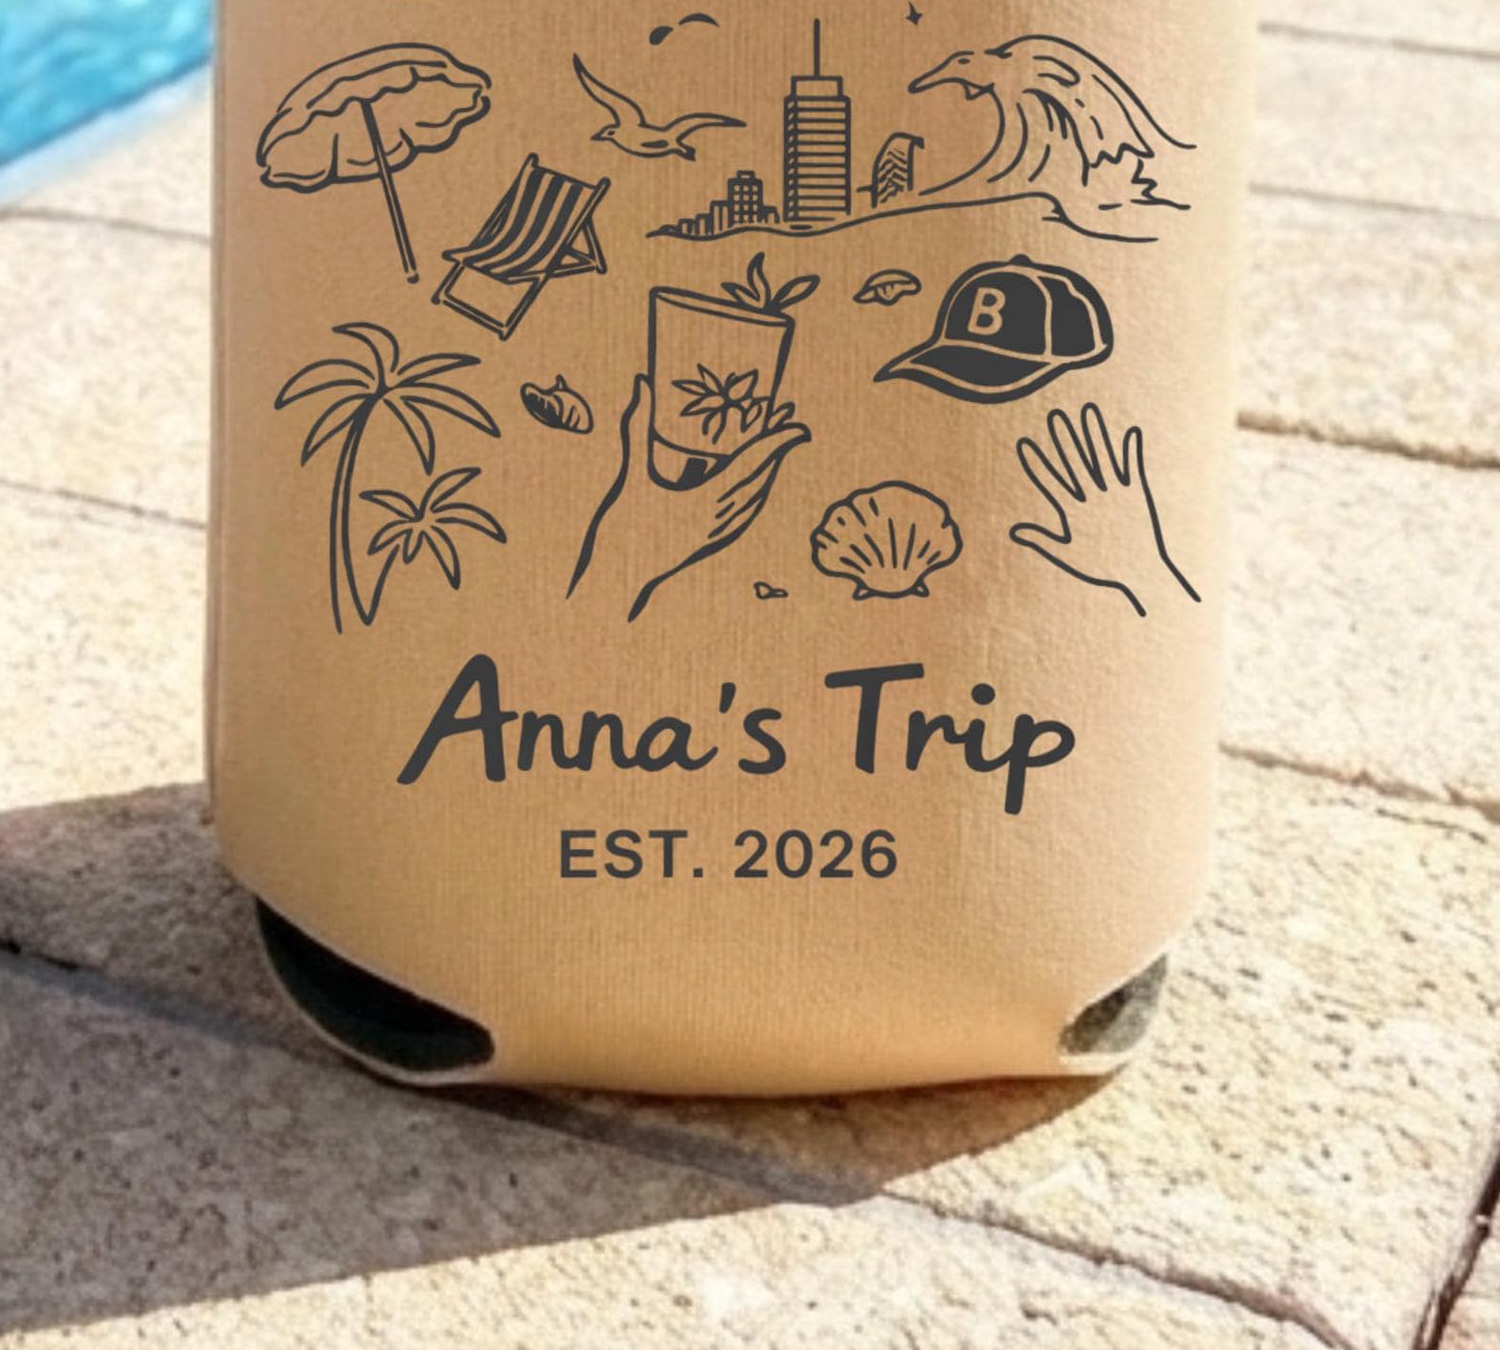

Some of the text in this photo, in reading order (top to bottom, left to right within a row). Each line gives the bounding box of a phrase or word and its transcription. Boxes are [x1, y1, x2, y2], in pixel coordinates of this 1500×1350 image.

[967, 287, 1006, 336] B
[396, 653, 1076, 816] Anna's Trip
[560, 829, 898, 880] EST. 2026
